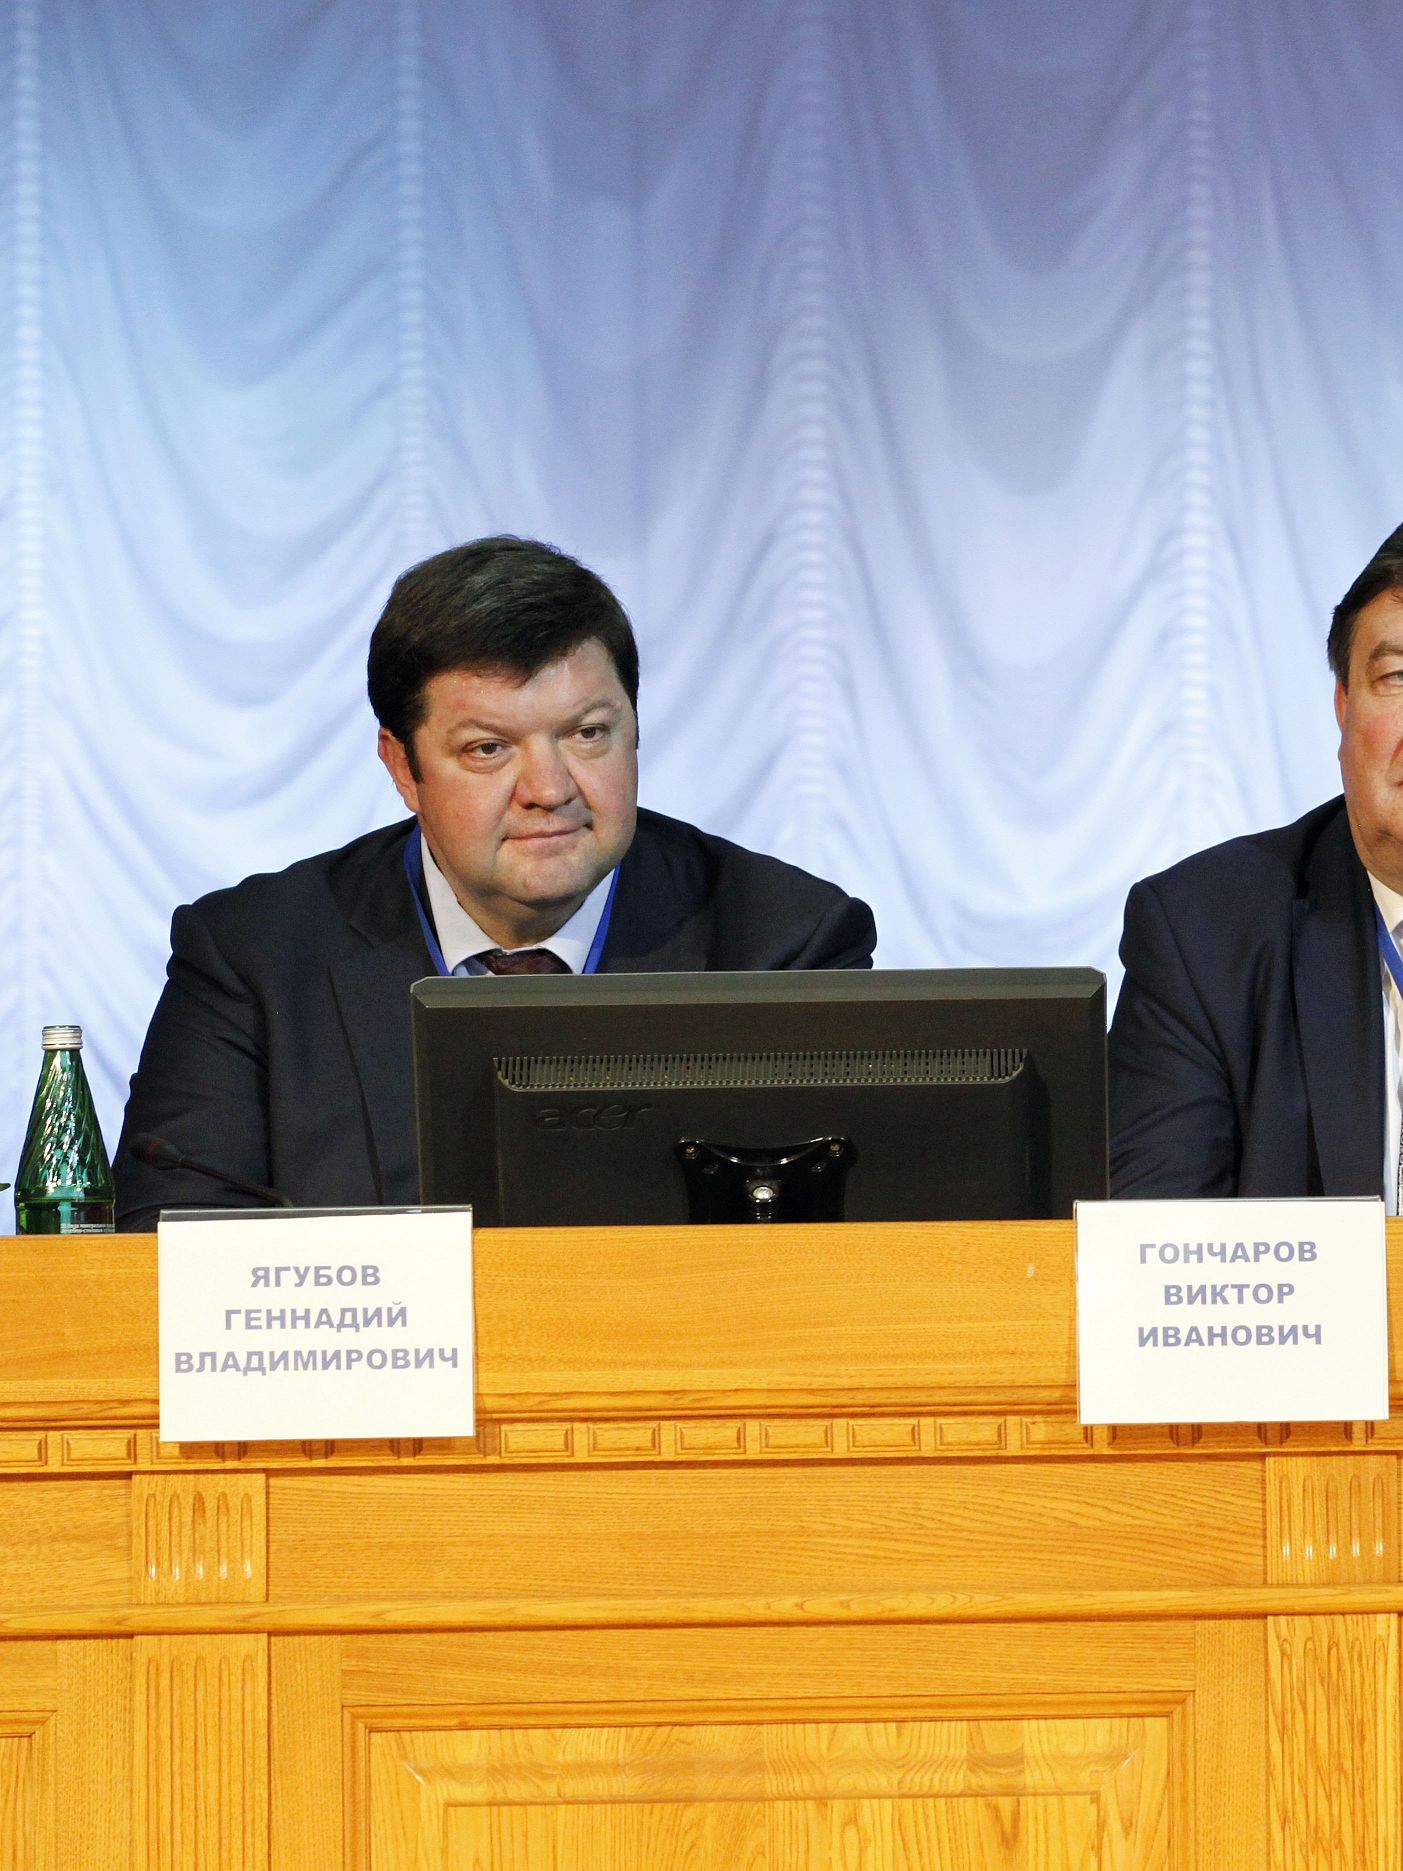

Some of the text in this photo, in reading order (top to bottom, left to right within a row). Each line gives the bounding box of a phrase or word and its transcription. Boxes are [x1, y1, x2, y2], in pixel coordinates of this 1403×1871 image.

[535, 1103, 653, 1131] acer
[1139, 1240, 1318, 1265] ГОНЧАРОВ
[250, 1265, 381, 1289] ЯГУБОВ
[1163, 1283, 1295, 1306] ВИКТОР
[224, 1301, 408, 1332] ГЕННАДИЙ
[1138, 1323, 1322, 1348] ИВАНОВИЧ
[174, 1347, 459, 1375] ВЛАДИМИРОВИЧ
